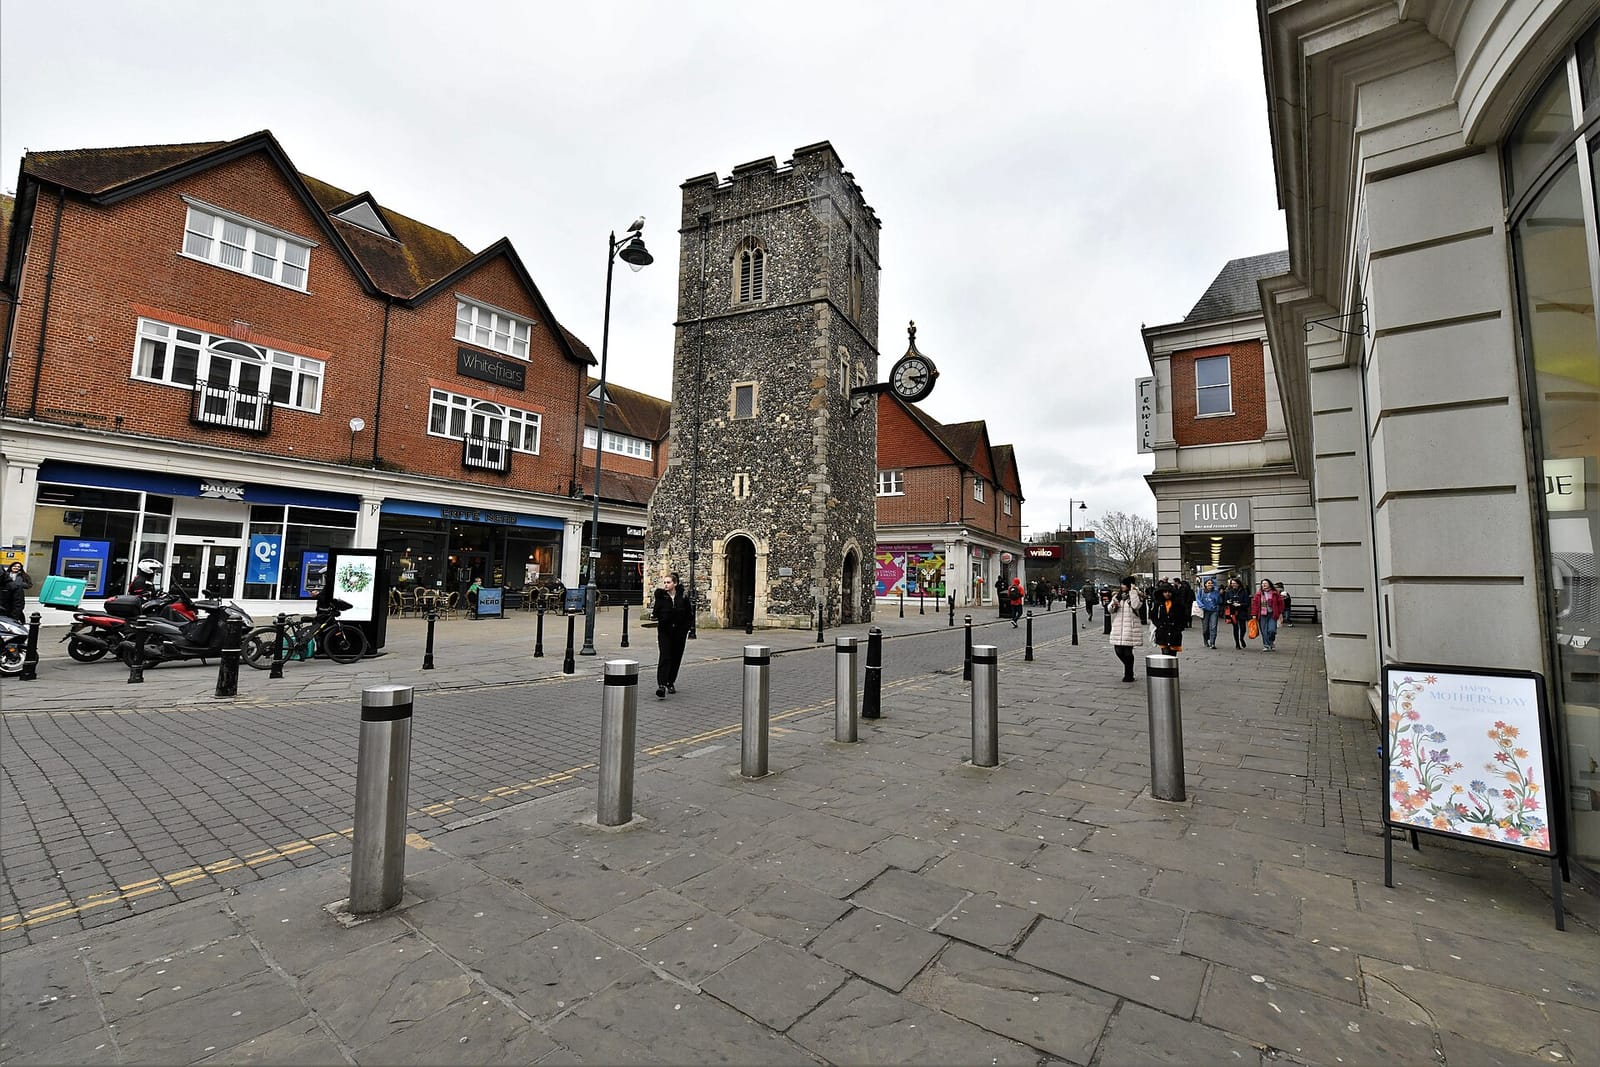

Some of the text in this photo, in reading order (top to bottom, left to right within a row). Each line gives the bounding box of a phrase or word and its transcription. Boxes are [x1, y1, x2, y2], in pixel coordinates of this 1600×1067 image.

[462, 353, 522, 382] Whitefriars
[1138, 380, 1152, 449] Fenwick
[200, 484, 245, 495] HALIFAX
[1194, 502, 1238, 521] FUEGO
[1030, 548, 1053, 557] wilko
[1460, 684, 1492, 693] HAPPY
[1429, 691, 1528, 707] MOTHER'S DAY
